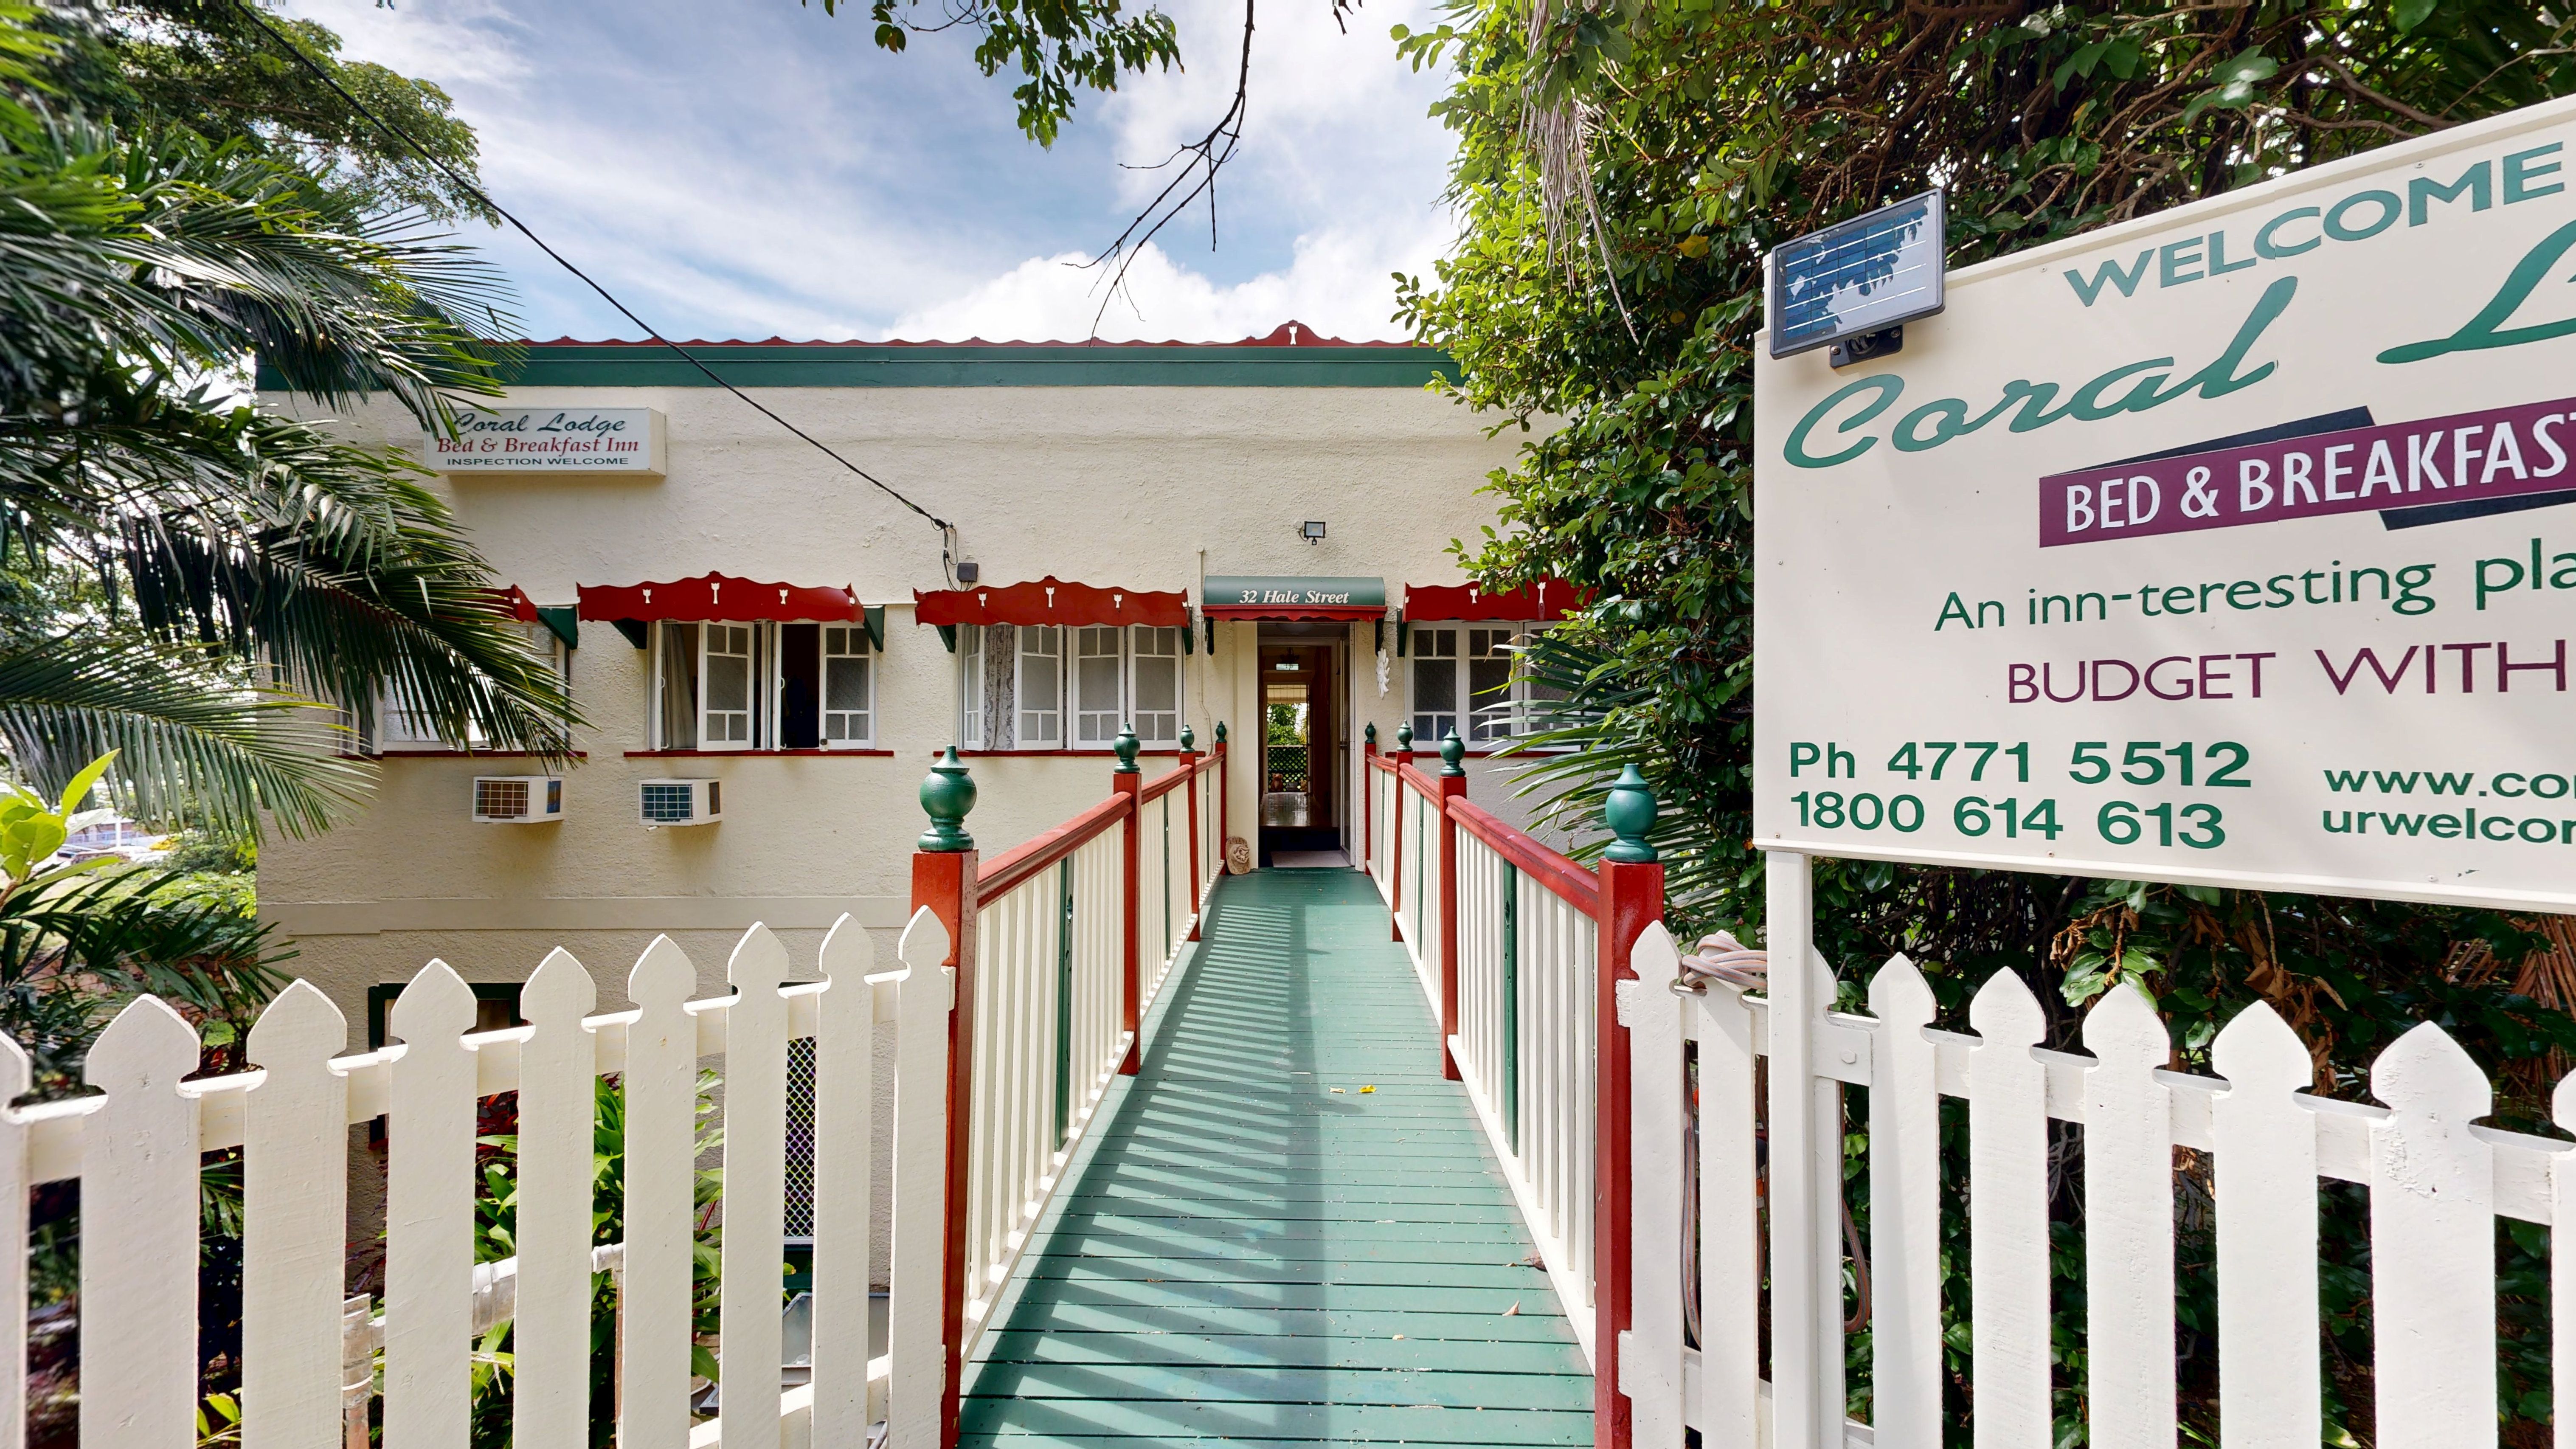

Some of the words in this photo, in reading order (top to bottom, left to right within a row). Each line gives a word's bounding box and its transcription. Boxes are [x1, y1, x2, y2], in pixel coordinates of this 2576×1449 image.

[2064, 141, 2565, 307] WELCOME
[1783, 276, 2298, 468] Coral
[437, 438, 474, 453] Bed
[481, 437, 498, 453] &
[504, 437, 600, 457] Breakfast
[605, 437, 639, 452] Inn
[453, 413, 529, 435] Coral
[537, 412, 626, 438] Lodge
[447, 458, 542, 466] INSPECTION
[547, 457, 629, 465] WELCOME
[2066, 475, 2161, 533] BED
[2180, 466, 2219, 518] &
[2239, 412, 2576, 513] BREAKFAS
[1239, 590, 1257, 603] 32
[1262, 590, 1299, 603] Hale
[1305, 590, 1350, 604] Street
[1935, 591, 2005, 631] An
[2029, 560, 2436, 626] inn-teresting
[2009, 652, 2276, 703] BUDGET
[2314, 639, 2567, 695] WITH
[1790, 742, 1856, 779] Ph
[1887, 741, 2029, 782] 4771
[2069, 741, 2252, 787] 5512
[2323, 770, 2576, 799] www.co
[1791, 791, 1926, 833] 1800
[1953, 798, 2064, 840] 614
[2097, 801, 2226, 849] 613
